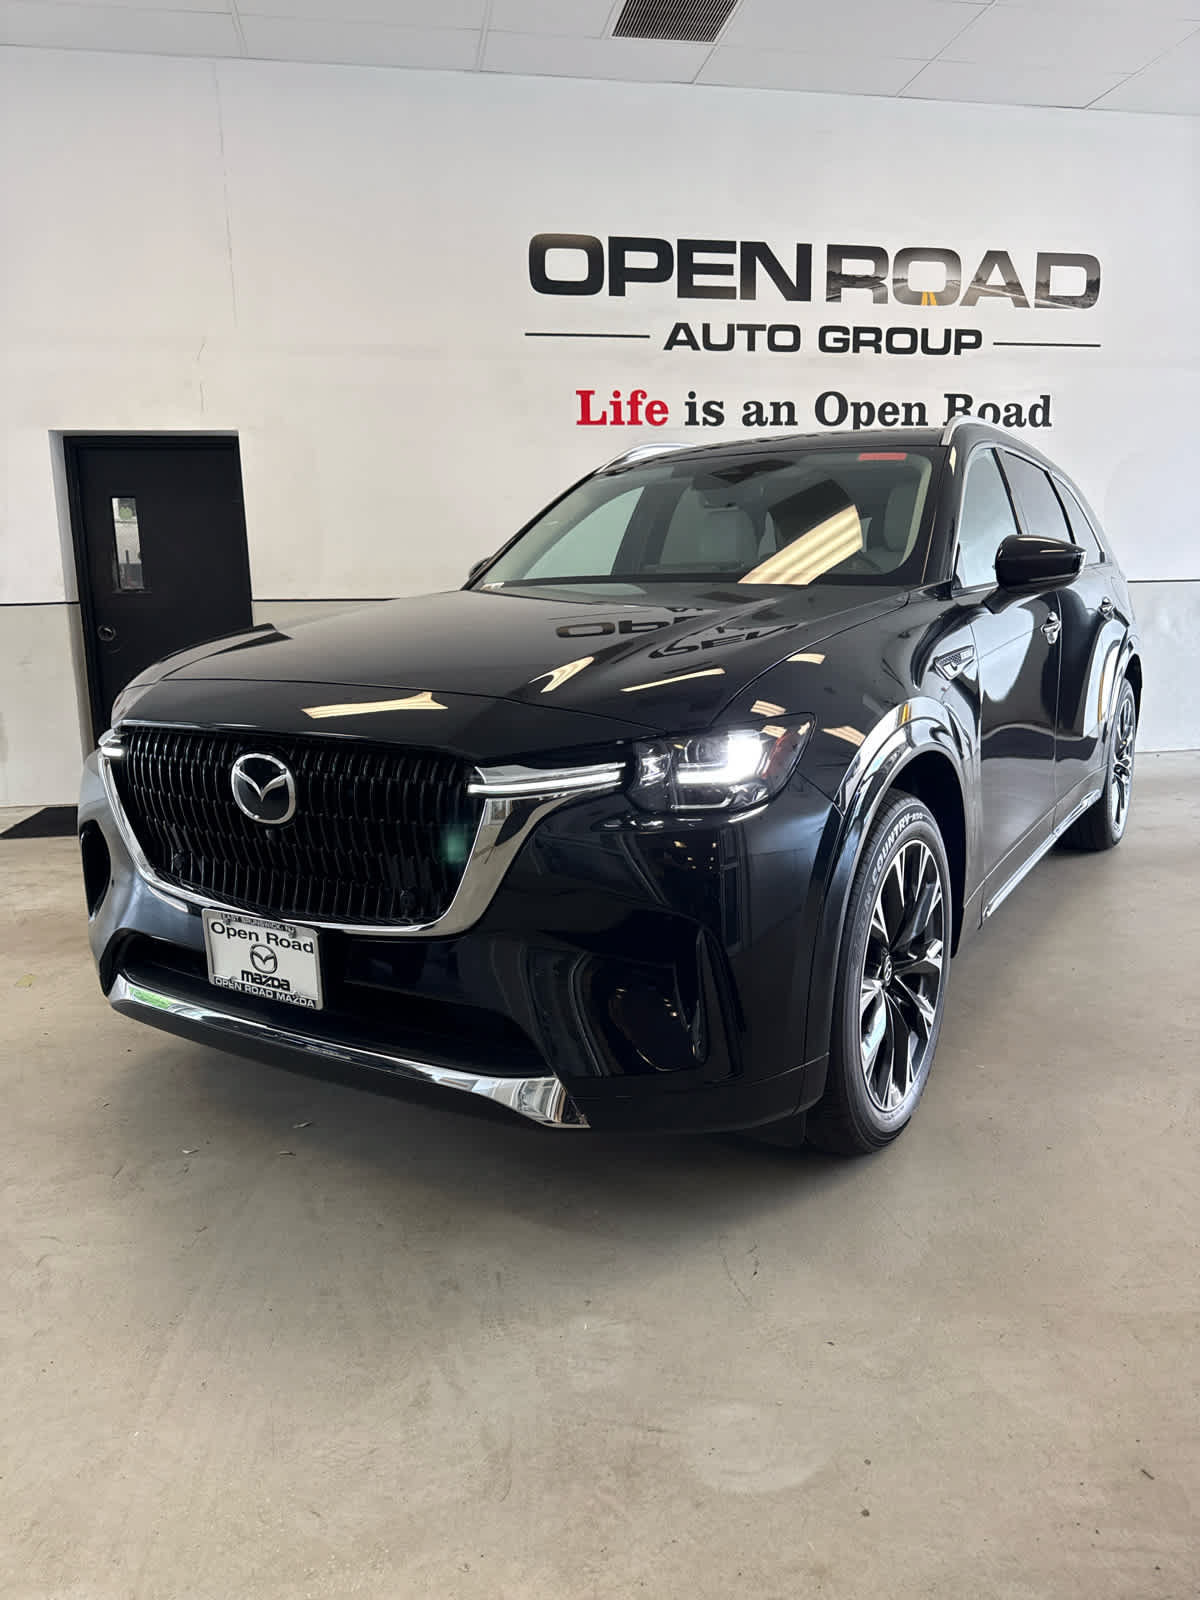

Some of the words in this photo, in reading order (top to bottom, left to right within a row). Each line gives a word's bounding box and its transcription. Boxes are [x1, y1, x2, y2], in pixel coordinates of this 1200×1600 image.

[528, 233, 812, 302] OPEN
[825, 243, 1101, 309] ROAD
[664, 322, 801, 353] AUTO
[818, 325, 982, 356] GROUP
[576, 389, 669, 426] Life
[684, 391, 725, 427] is
[742, 400, 798, 427] an
[814, 391, 929, 430] Open
[942, 393, 1052, 428] Road
[872, 812, 911, 886] COUNTRY
[210, 921, 260, 942] Open
[266, 931, 315, 954] Road
[215, 977, 242, 991] OPEN
[244, 984, 274, 998] ROAD
[276, 992, 316, 1009] MAZDA
